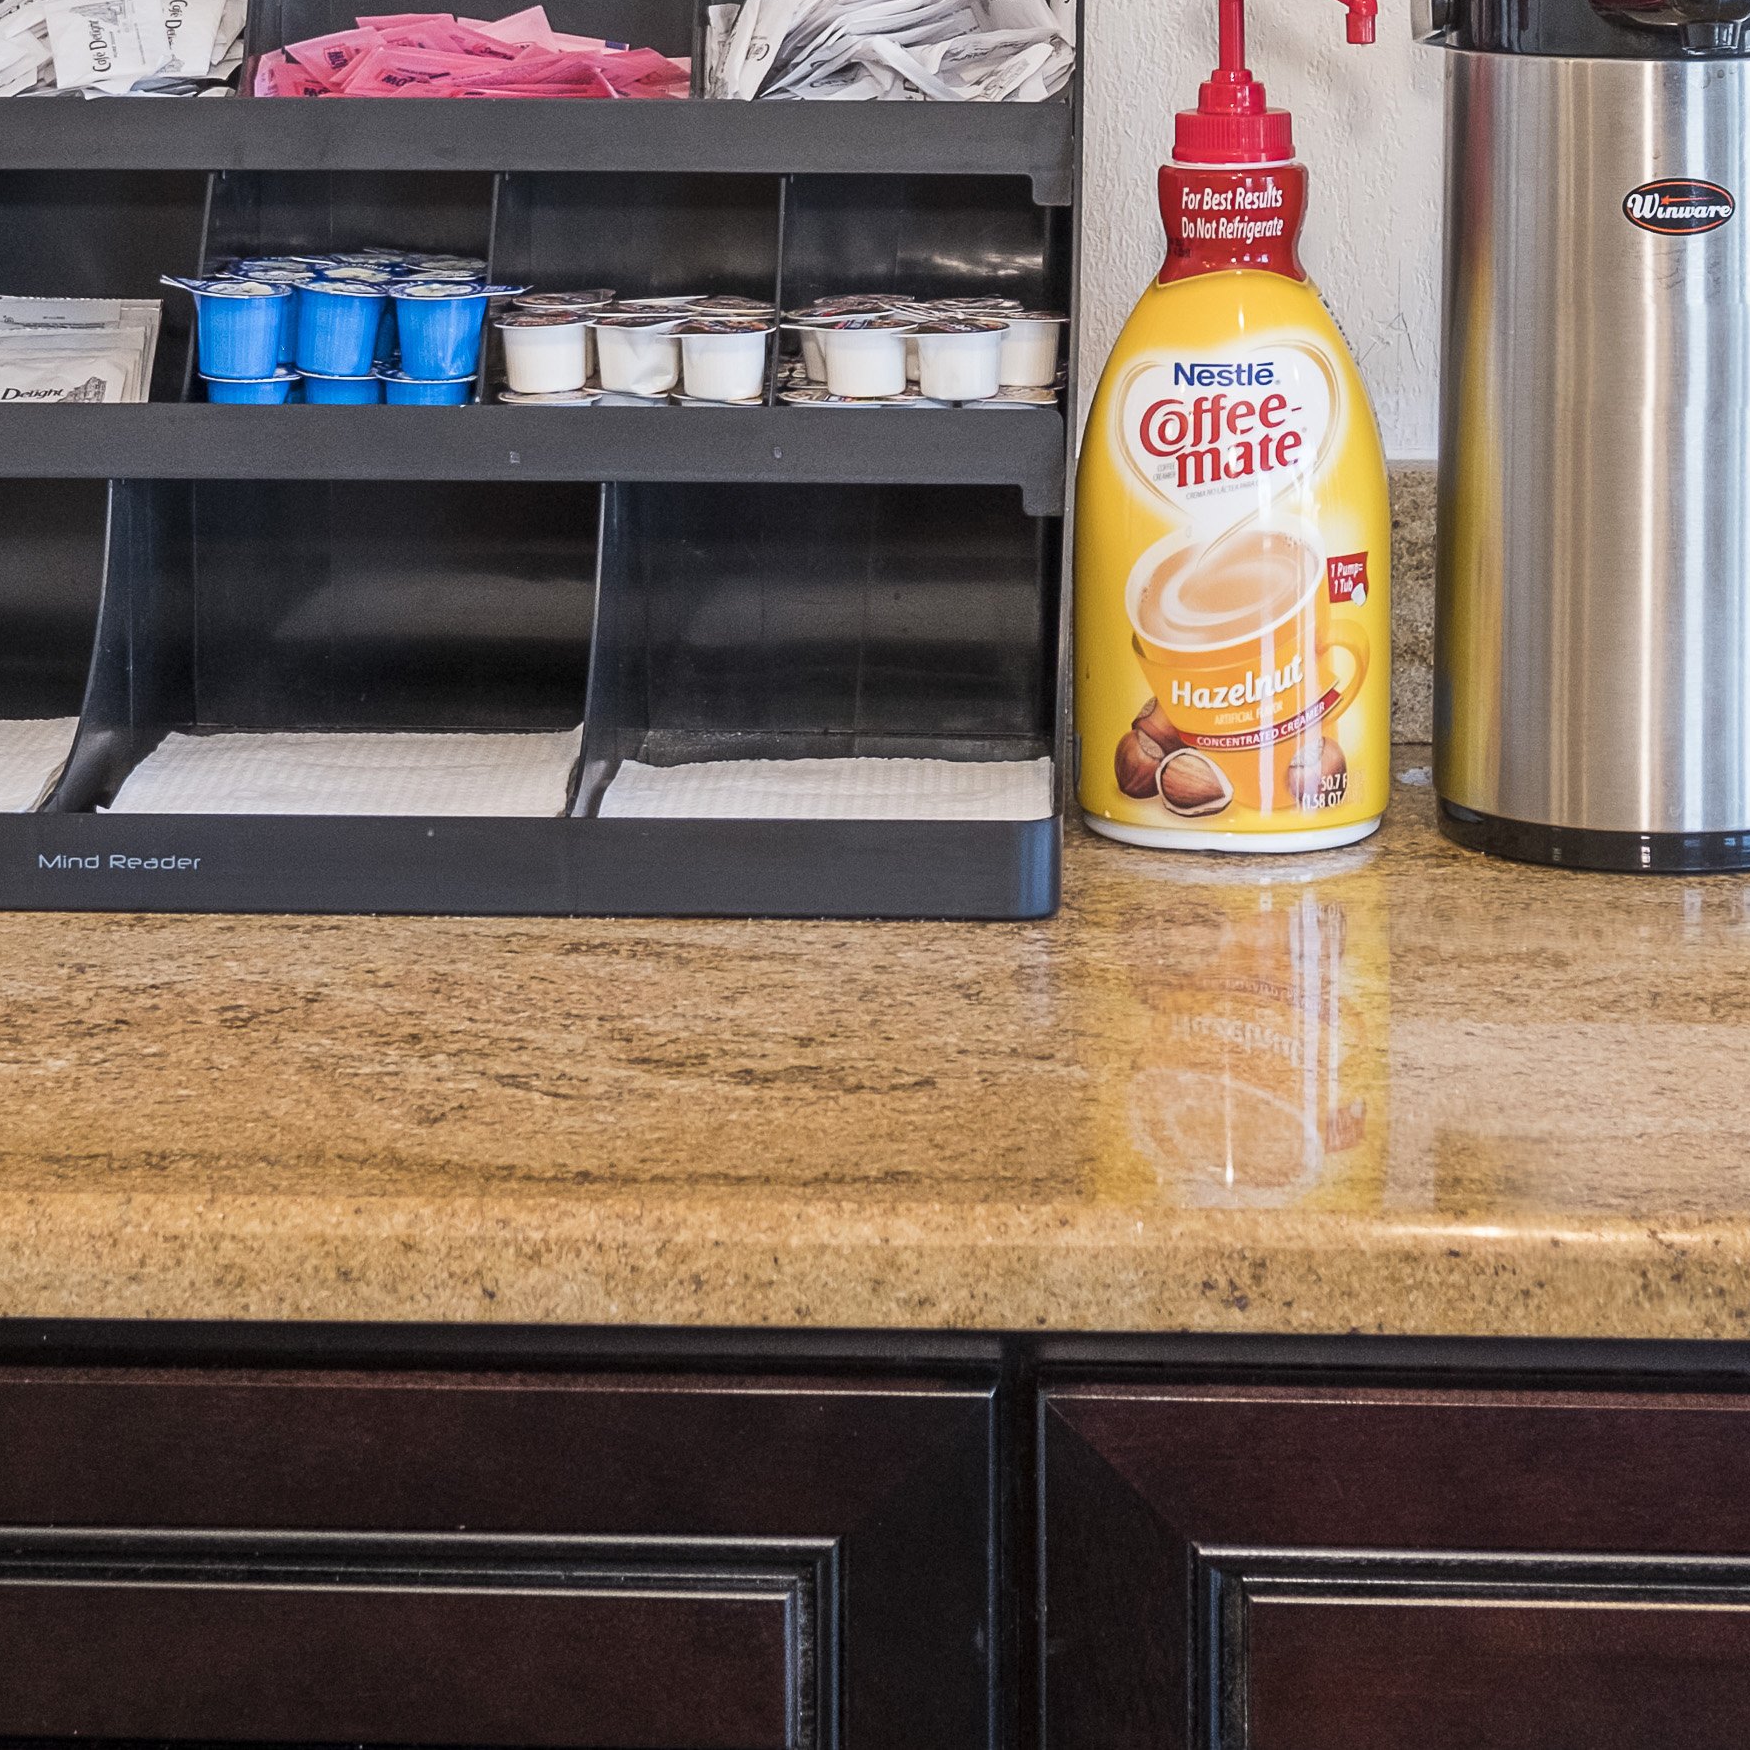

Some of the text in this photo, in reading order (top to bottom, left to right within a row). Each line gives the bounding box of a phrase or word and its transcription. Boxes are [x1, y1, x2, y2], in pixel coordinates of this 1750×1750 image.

[92, 51, 112, 72] Café
[1181, 184, 1283, 210] For Best Results
[1626, 193, 1733, 219] Winware
[1181, 216, 1284, 244] Do Not Refrigerate
[1173, 361, 1274, 387] Nestlé
[0, 387, 65, 400] Delight
[1175, 431, 1303, 488] mate
[1331, 563, 1336, 578] 1
[1334, 576, 1354, 595] 1 Tub
[1171, 654, 1304, 710] Hazelnut
[1196, 701, 1326, 747] CONCENTRATED CREAMER
[1321, 773, 1341, 792] 50.7
[38, 853, 201, 870] Mind Reader
